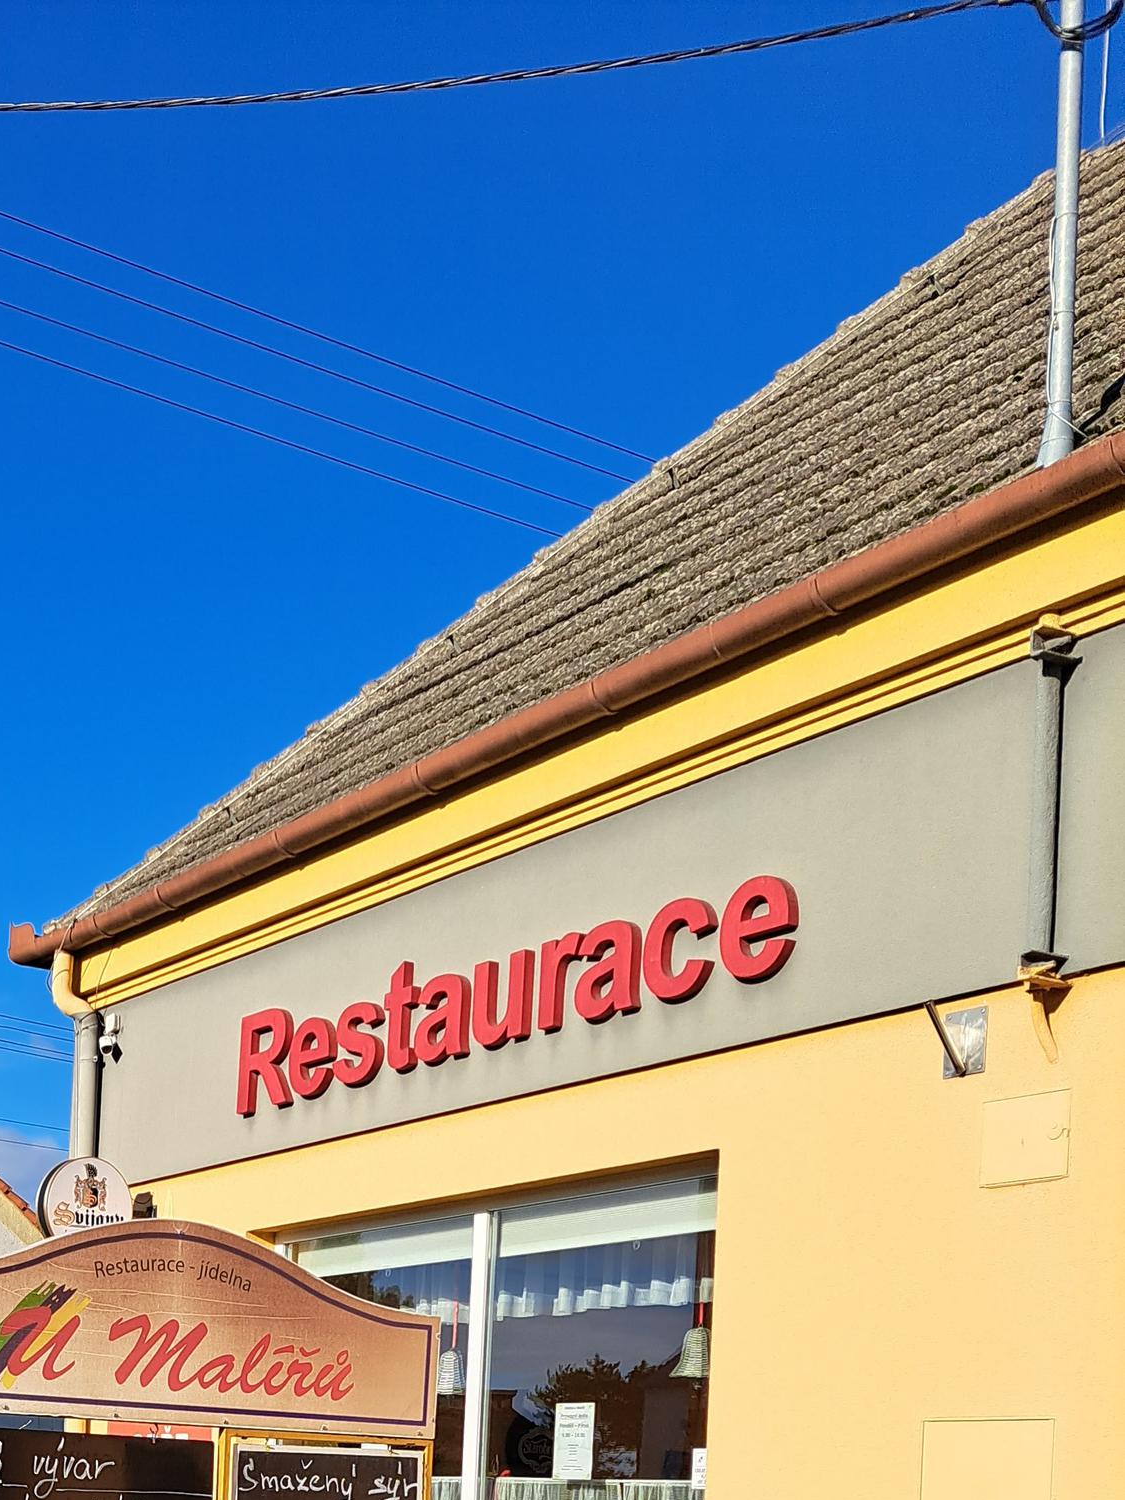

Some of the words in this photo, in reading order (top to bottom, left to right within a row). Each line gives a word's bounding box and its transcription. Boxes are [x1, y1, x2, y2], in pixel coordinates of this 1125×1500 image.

[236, 875, 800, 1118] Restaurace
[94, 1257, 185, 1278] Restaurace
[196, 1260, 252, 1293] jídelna
[0, 1305, 81, 1381] U
[108, 1314, 355, 1401] Malířů
[33, 1437, 115, 1499] vývar
